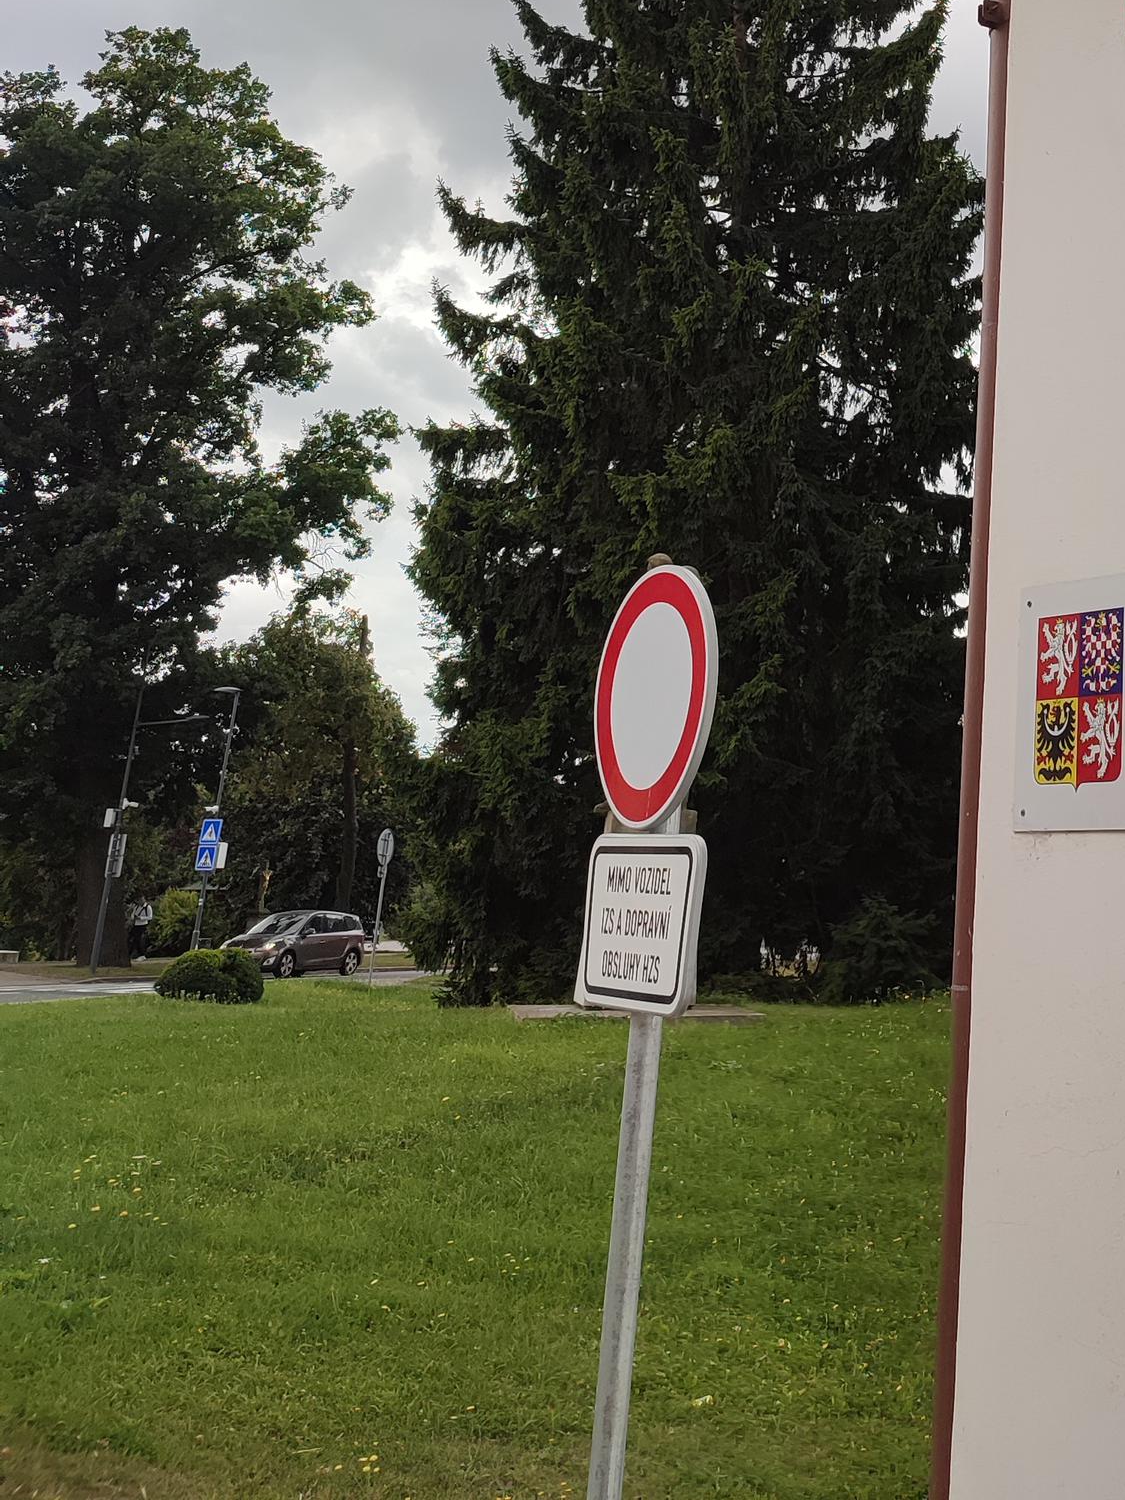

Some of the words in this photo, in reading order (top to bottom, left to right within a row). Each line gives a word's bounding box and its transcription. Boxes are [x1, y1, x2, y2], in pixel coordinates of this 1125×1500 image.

[606, 865, 632, 894] MIMO
[634, 866, 671, 896] VOZIDEL
[601, 907, 615, 935] IZS
[615, 908, 622, 936] A
[624, 905, 672, 940] DOPRAVNÍ
[601, 950, 640, 982] OBSLUHY
[641, 955, 661, 984] HZS
